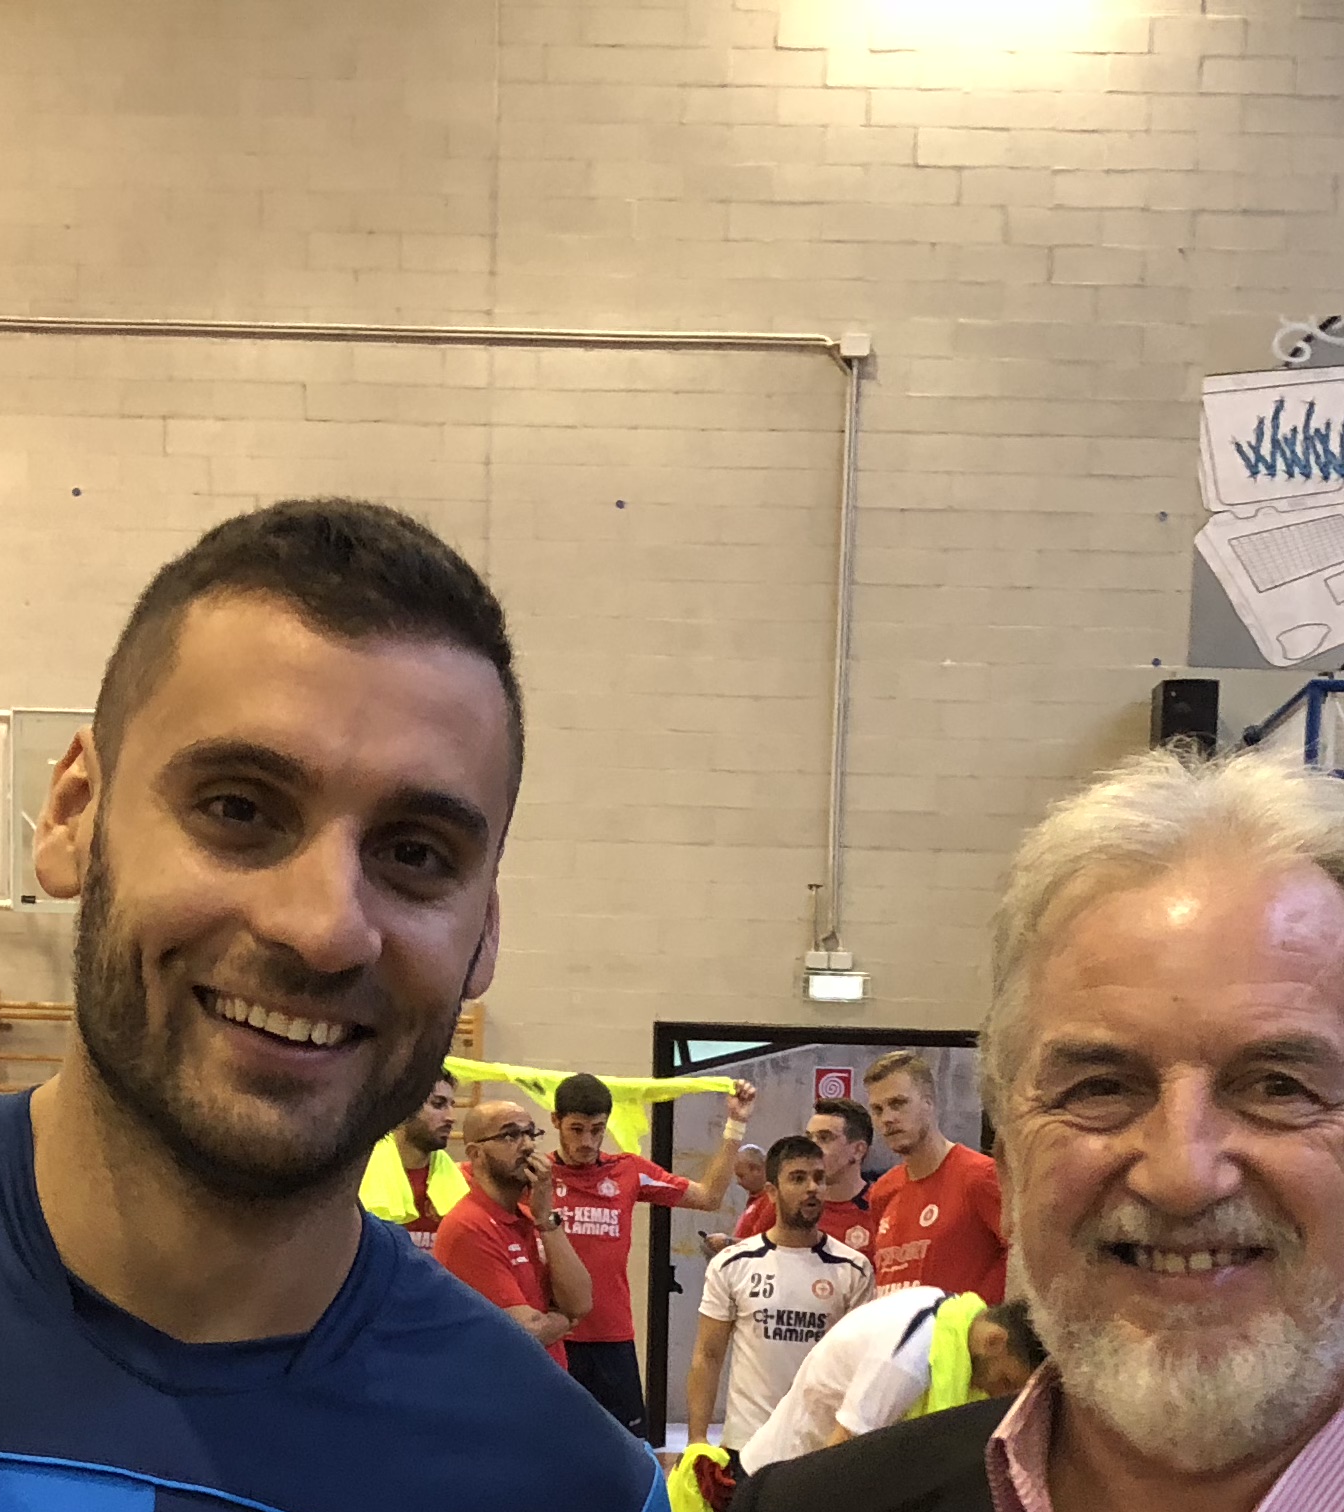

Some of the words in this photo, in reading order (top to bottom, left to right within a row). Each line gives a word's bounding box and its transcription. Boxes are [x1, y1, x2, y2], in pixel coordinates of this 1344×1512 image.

[574, 1206, 619, 1225] KEMAS
[749, 1272, 776, 1299] 25
[775, 1309, 828, 1329] KEMAS
